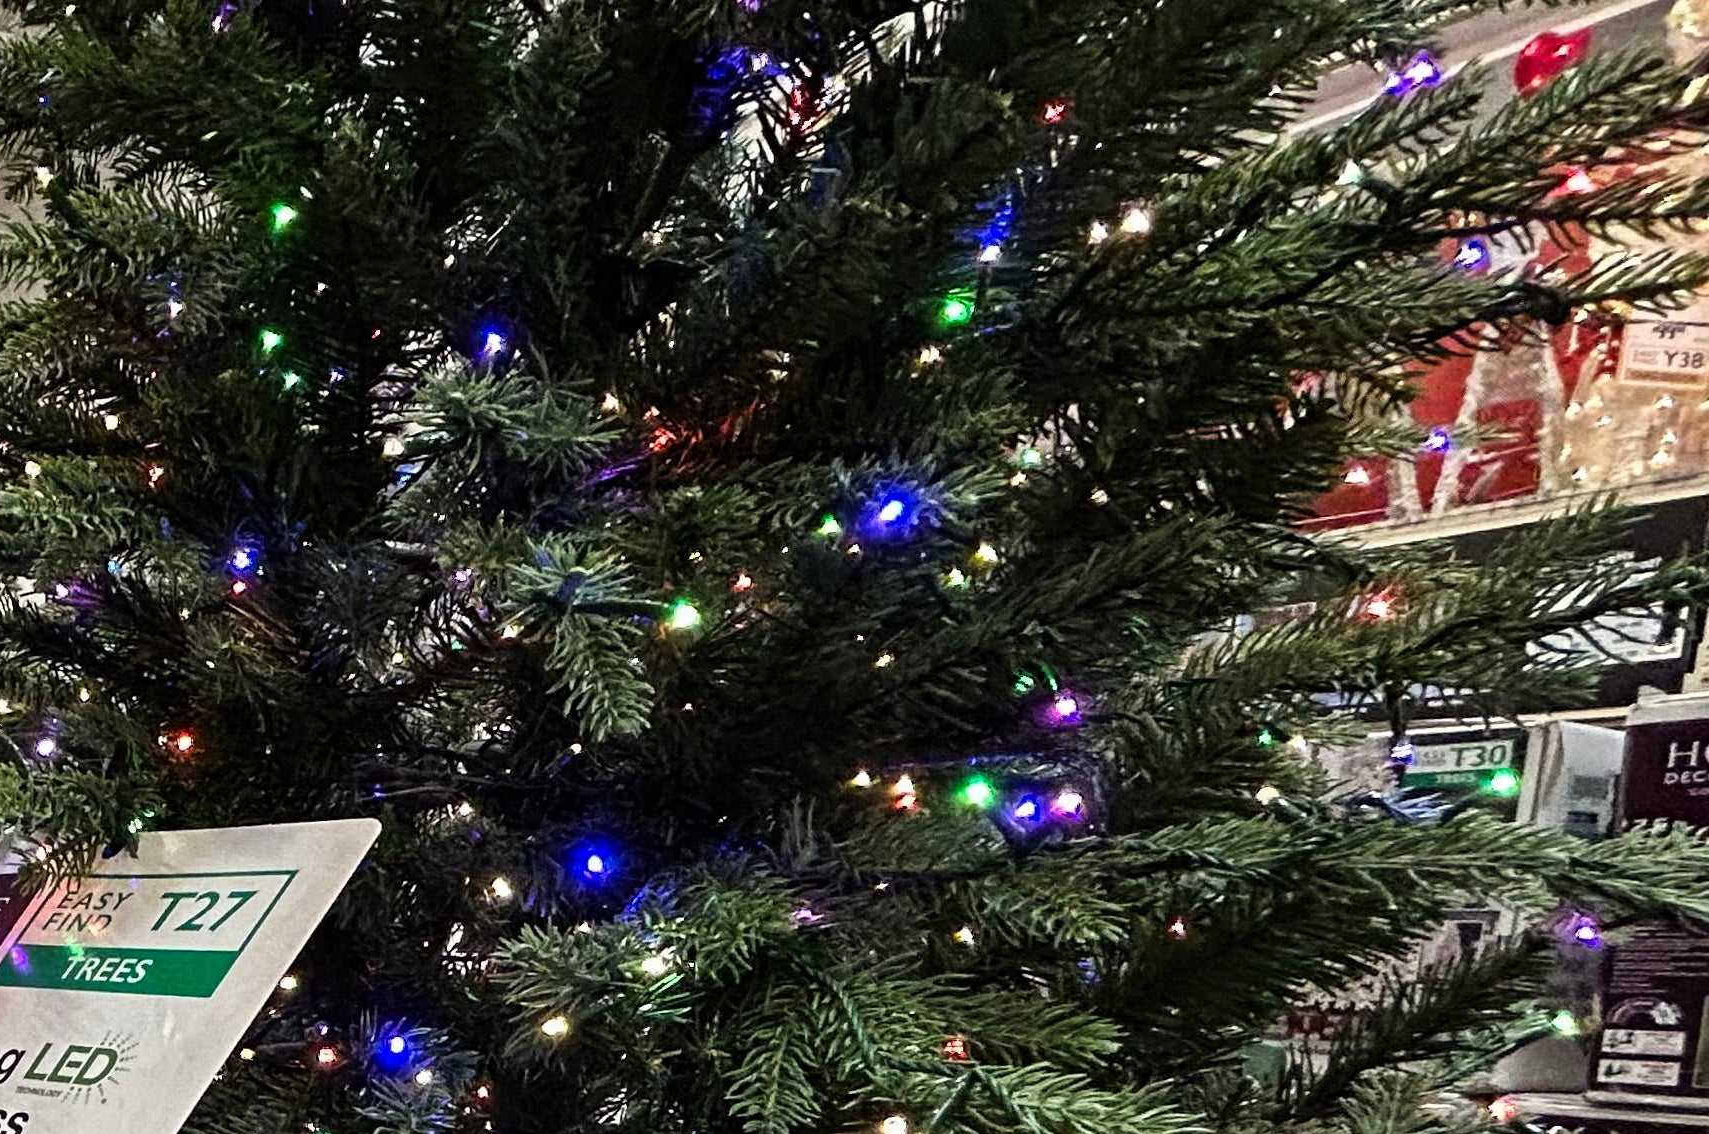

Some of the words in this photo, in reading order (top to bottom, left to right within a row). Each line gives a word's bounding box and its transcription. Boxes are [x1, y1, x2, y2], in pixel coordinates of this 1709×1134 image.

[1663, 350, 1705, 369] Y38
[1450, 745, 1507, 767] T30
[57, 890, 136, 912] EASY
[150, 890, 258, 932] T27
[41, 911, 113, 933] FIND
[61, 956, 154, 983] TREES
[23, 1043, 120, 1086] LED
